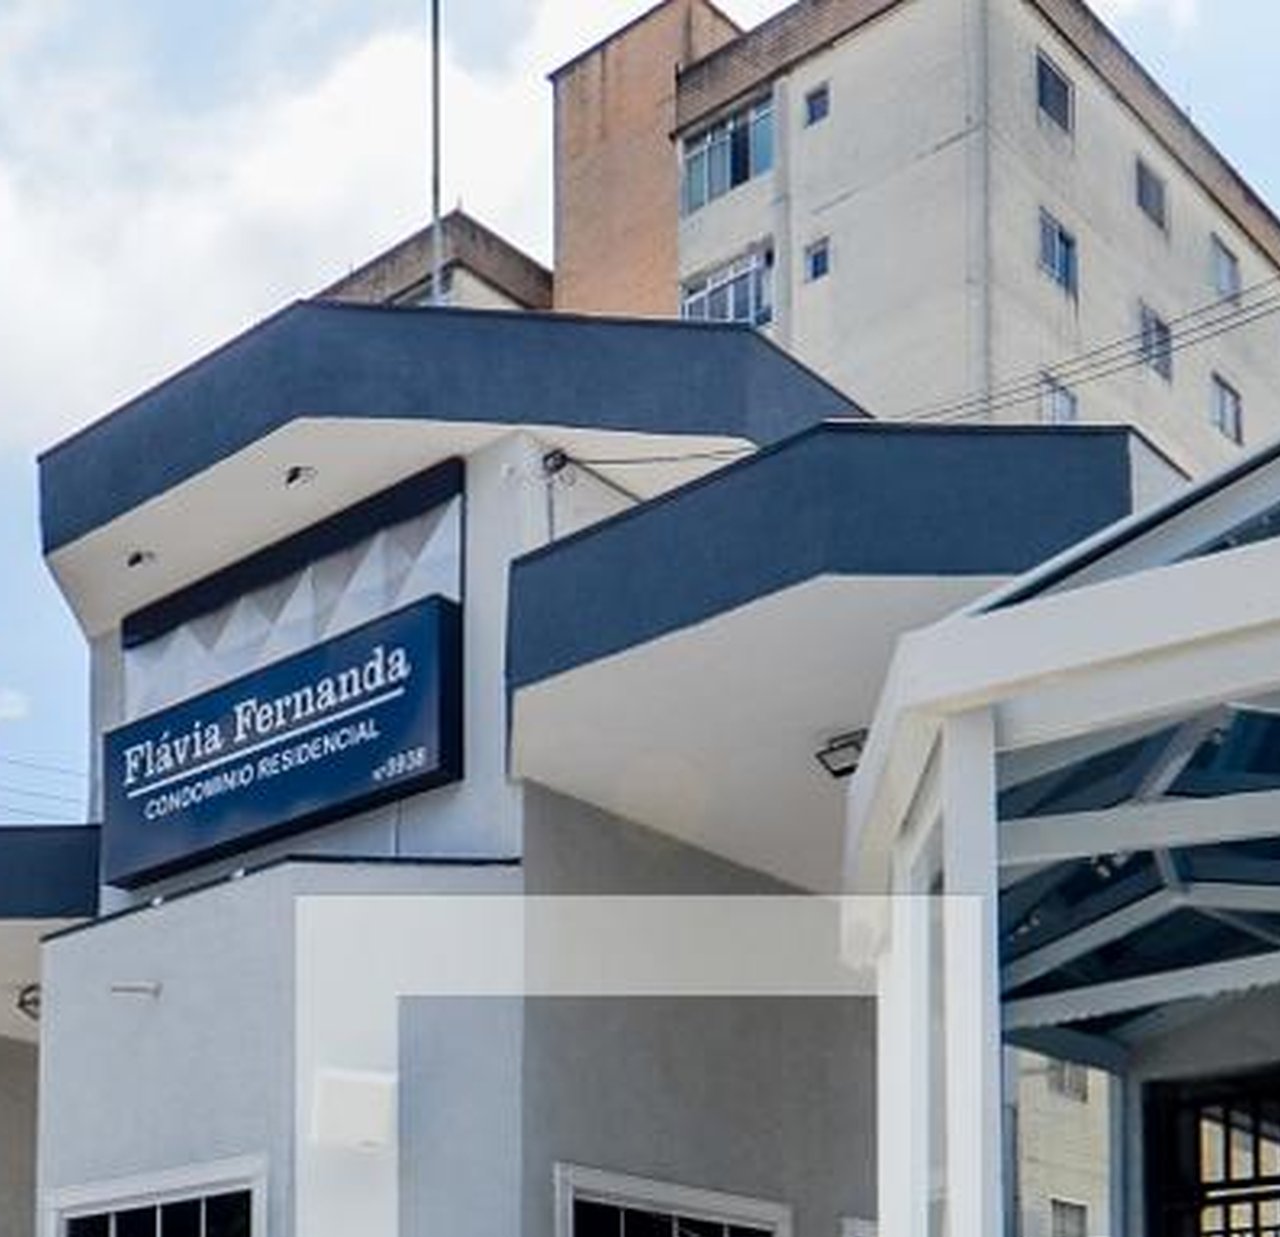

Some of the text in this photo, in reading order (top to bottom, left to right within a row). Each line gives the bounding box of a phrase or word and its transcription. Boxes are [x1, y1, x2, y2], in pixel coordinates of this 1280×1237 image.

[122, 644, 412, 786] Flávia Fernanda
[258, 718, 381, 780] RESIDENCIAL
